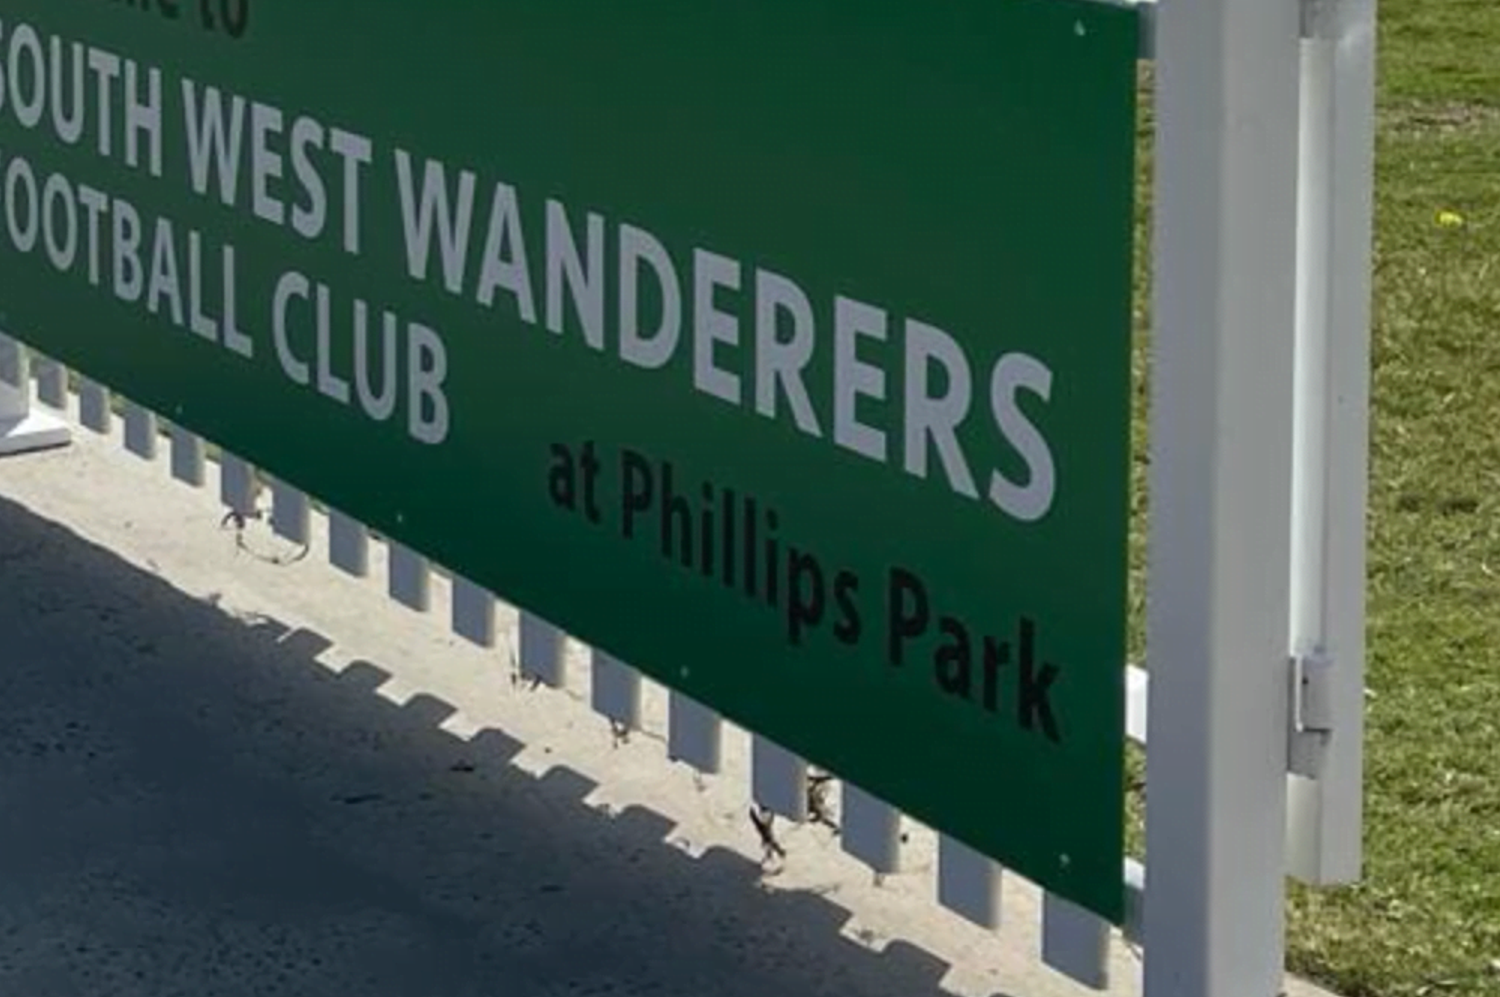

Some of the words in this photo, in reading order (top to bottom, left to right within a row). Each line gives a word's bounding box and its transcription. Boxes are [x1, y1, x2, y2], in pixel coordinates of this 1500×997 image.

[182, 77, 372, 255] WEST
[394, 148, 1057, 523] WANDERERS
[273, 271, 450, 446] CLUB
[548, 440, 601, 526] at
[621, 449, 862, 647] Phillips
[888, 566, 1062, 746] Park
